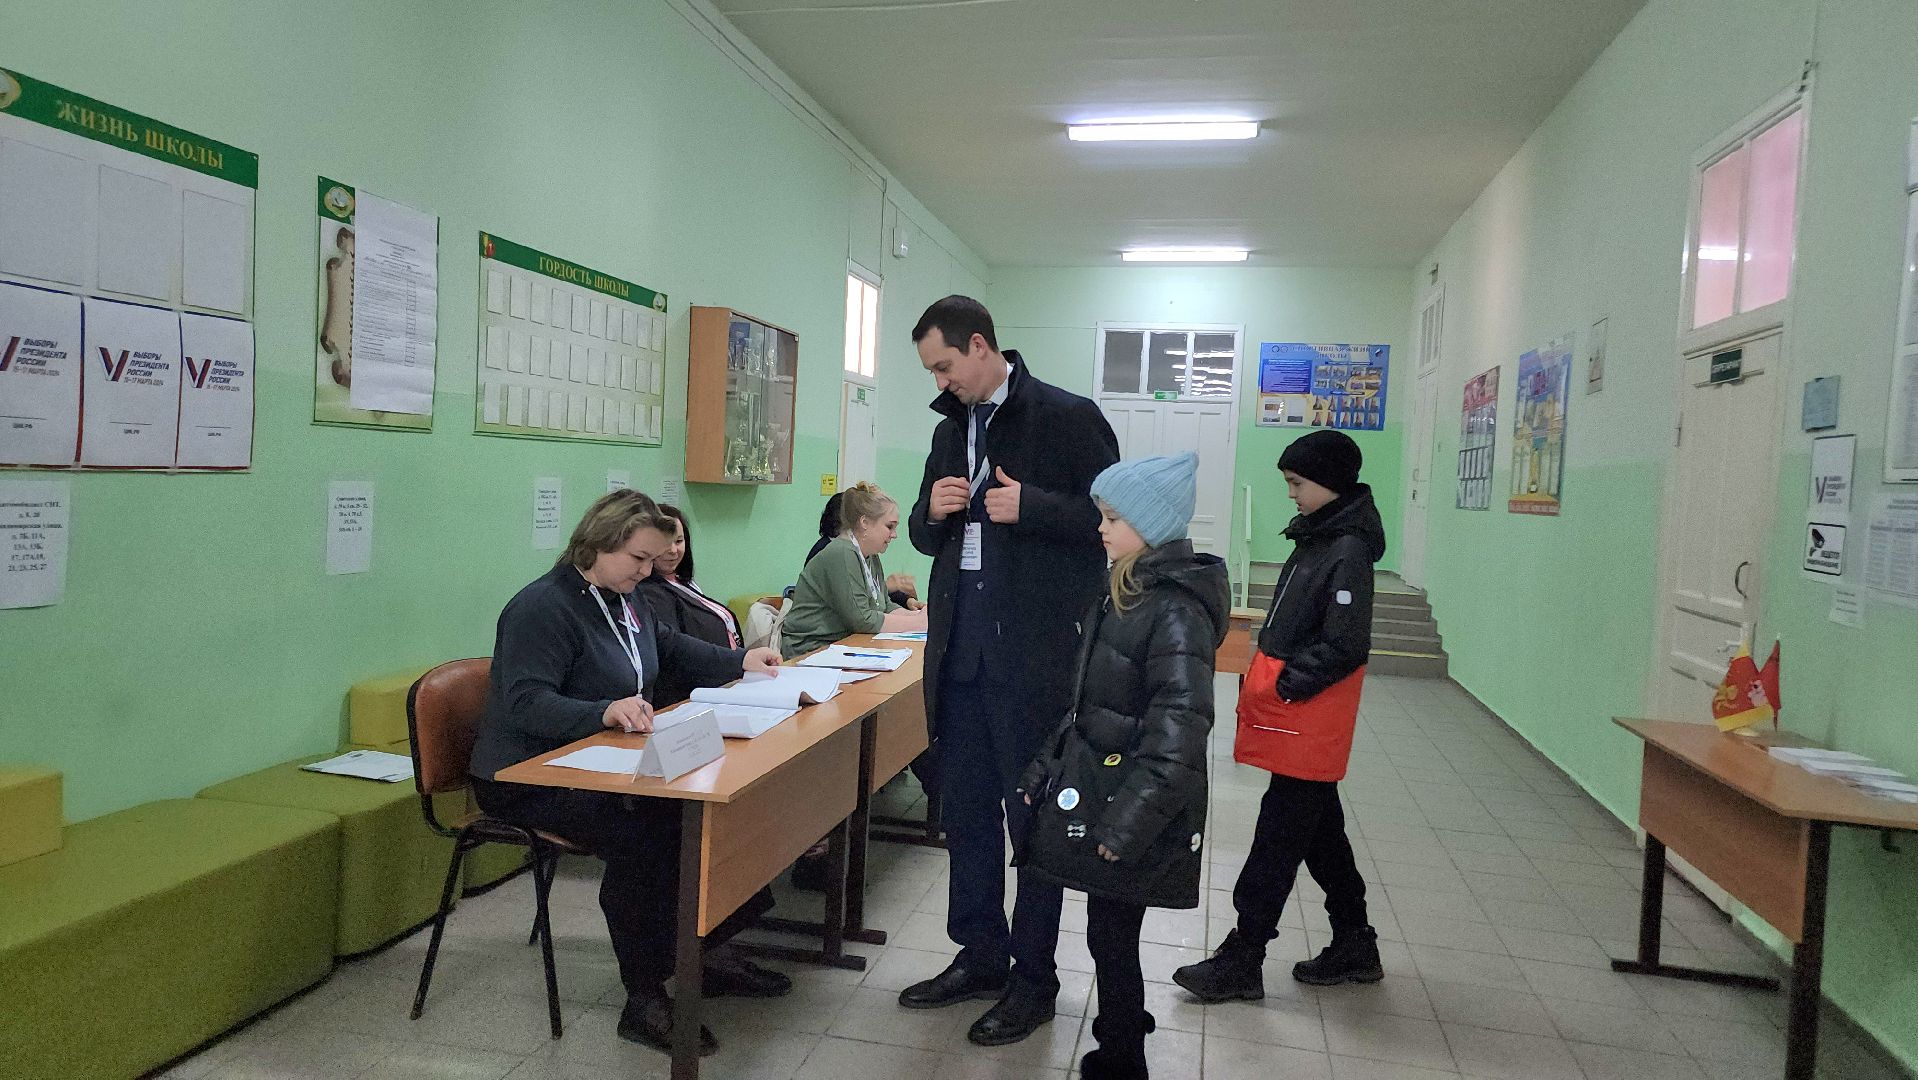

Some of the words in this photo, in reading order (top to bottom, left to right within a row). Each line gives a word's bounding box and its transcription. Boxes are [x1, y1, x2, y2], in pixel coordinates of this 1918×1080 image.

[57, 99, 139, 143] ЖИЗНЬ
[144, 128, 224, 171] ШКОЛЫ
[539, 256, 592, 286] ГОРДОСТЬ
[594, 275, 629, 298] ШКОЛЫ
[24, 338, 58, 348] ВЫБОРЫ
[20, 347, 67, 359] ПРЕЗИДЕНТА
[133, 351, 163, 361] ВЫБОРЫ
[16, 356, 47, 367] РОССИИ
[130, 359, 170, 370] ПРЕЗИДЕНТА
[214, 360, 238, 369] ВЫБОРЫ
[126, 368, 153, 378] РОССИИ
[208, 375, 231, 385] РОССИИ
